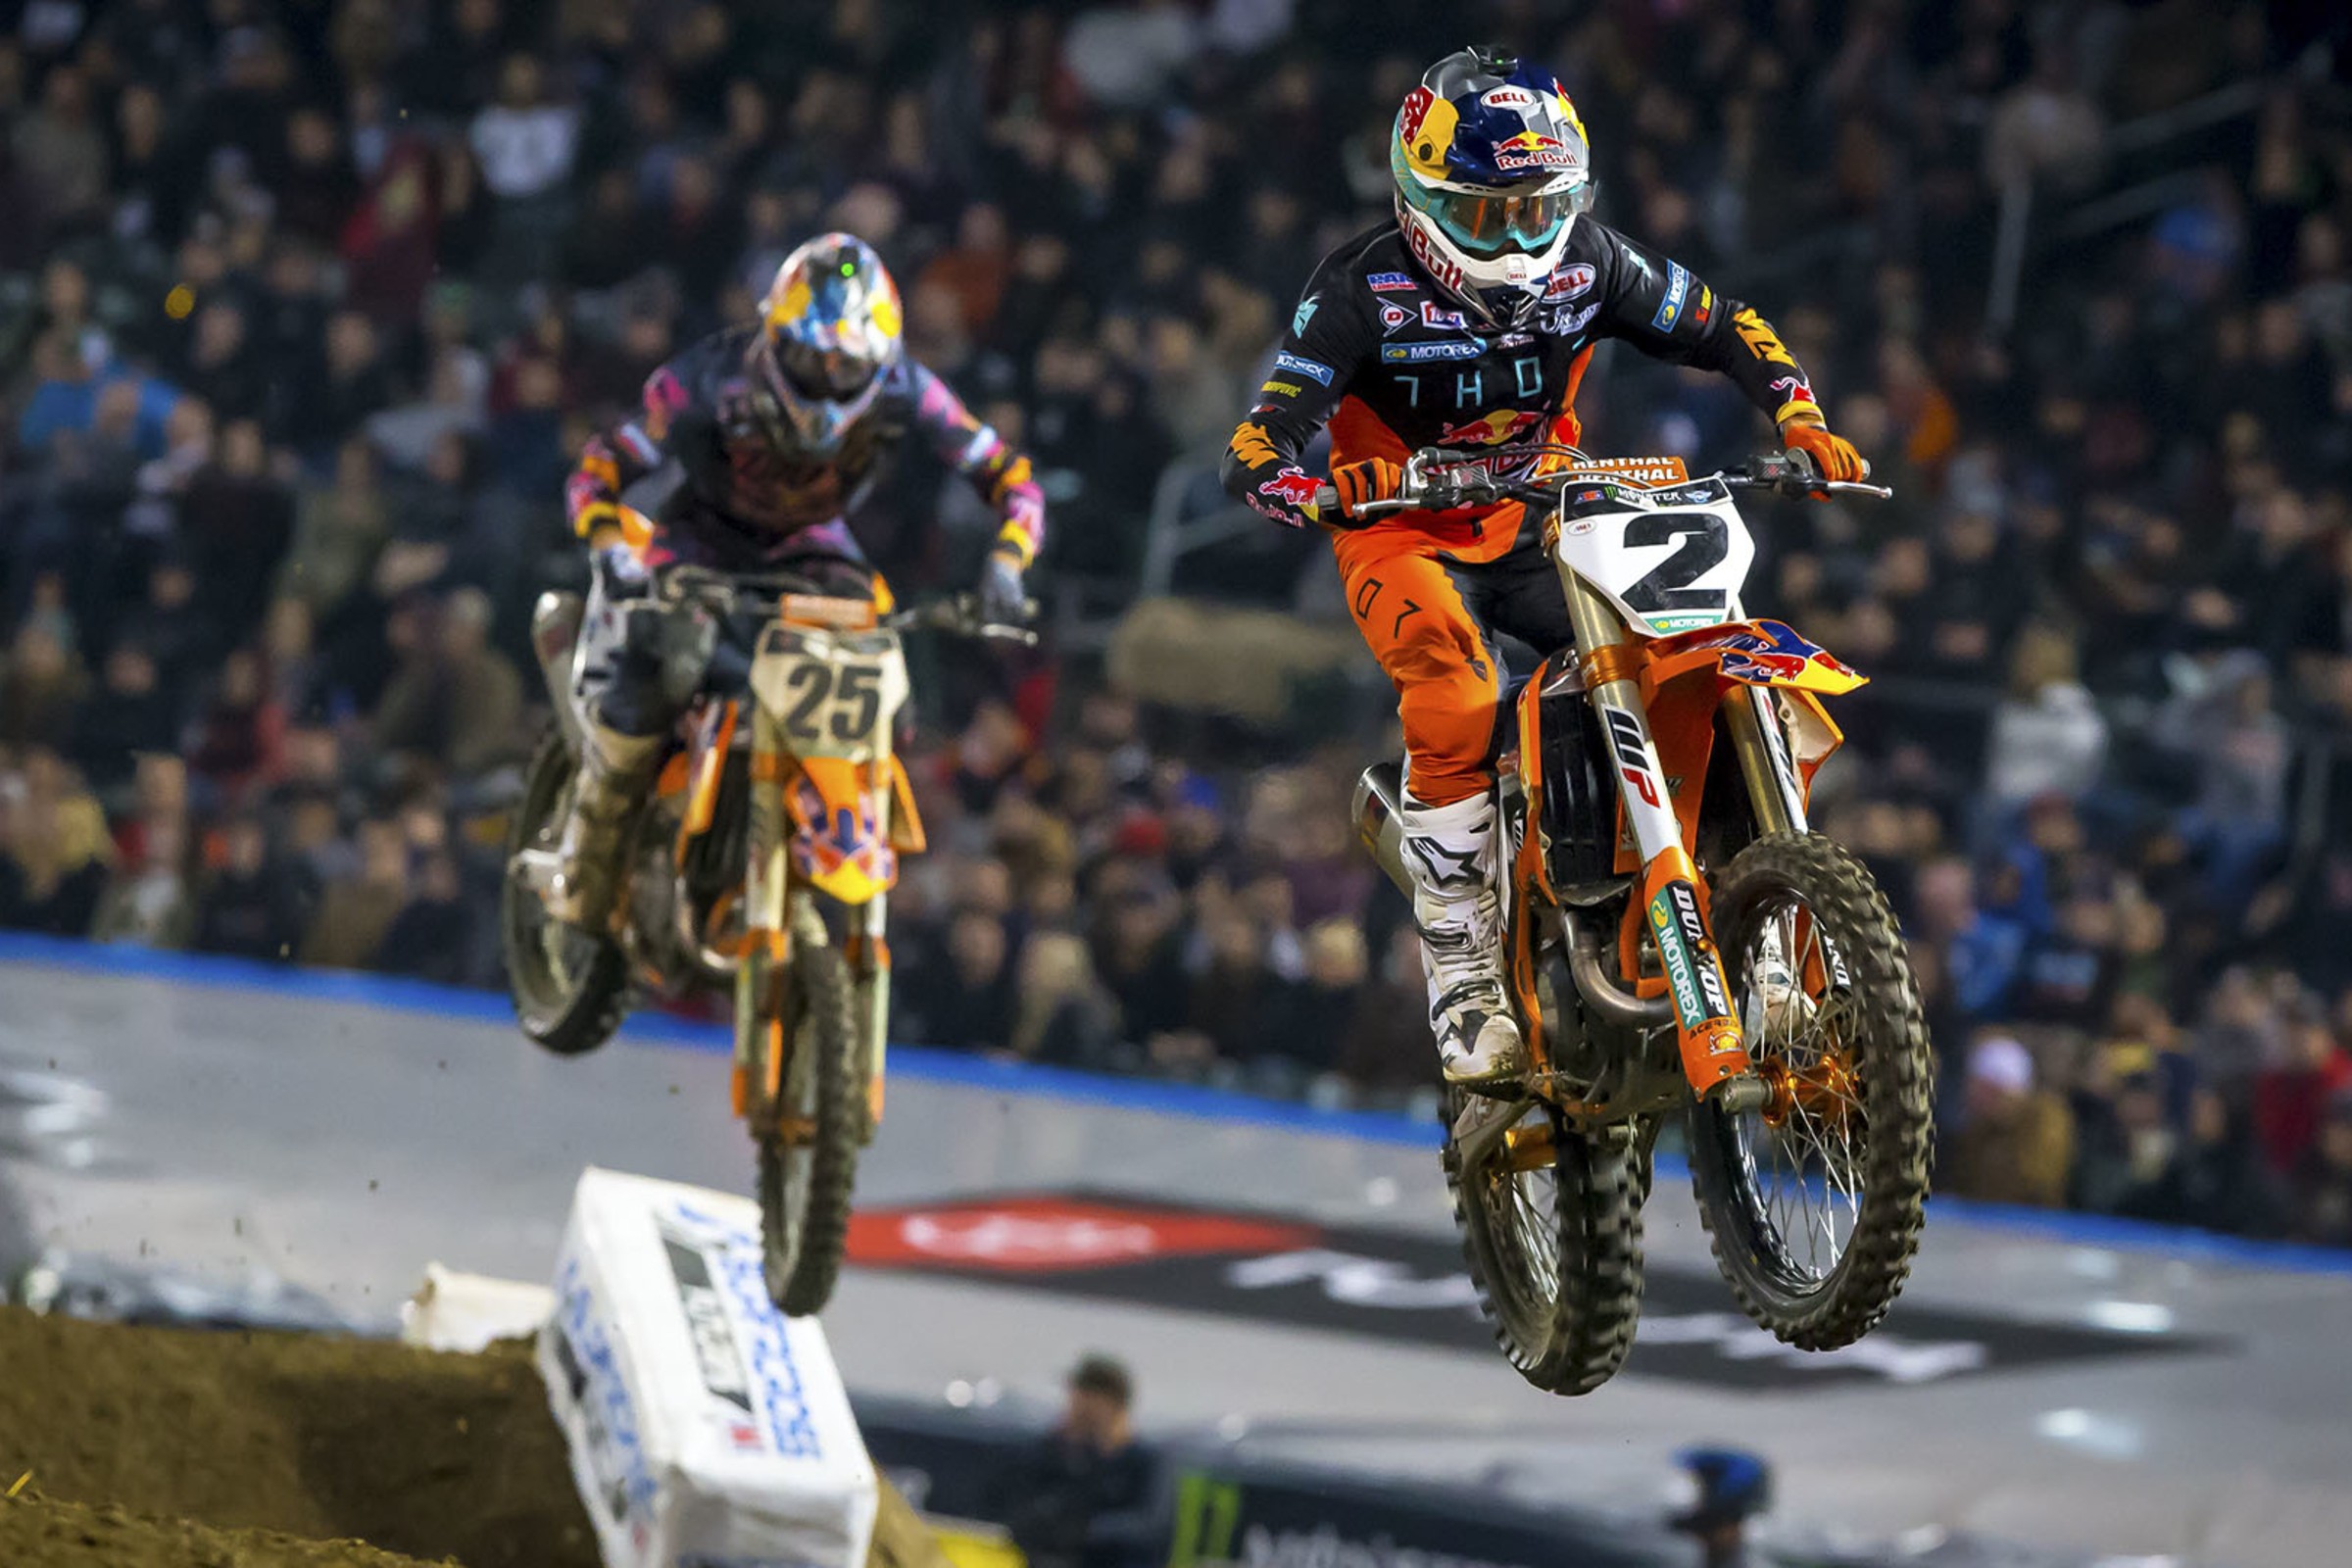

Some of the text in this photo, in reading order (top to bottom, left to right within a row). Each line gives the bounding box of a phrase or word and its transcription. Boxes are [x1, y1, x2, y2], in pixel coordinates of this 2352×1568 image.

[1490, 92, 1529, 104] BELL
[1497, 152, 1578, 170] Red Bull
[1411, 224, 1463, 292] Bull
[1547, 270, 1590, 297] BELL
[1572, 457, 1674, 469] RENTHAL
[1620, 513, 1728, 613] 2
[788, 664, 882, 740] 25
[1659, 926, 1700, 1025] MOTOREX
